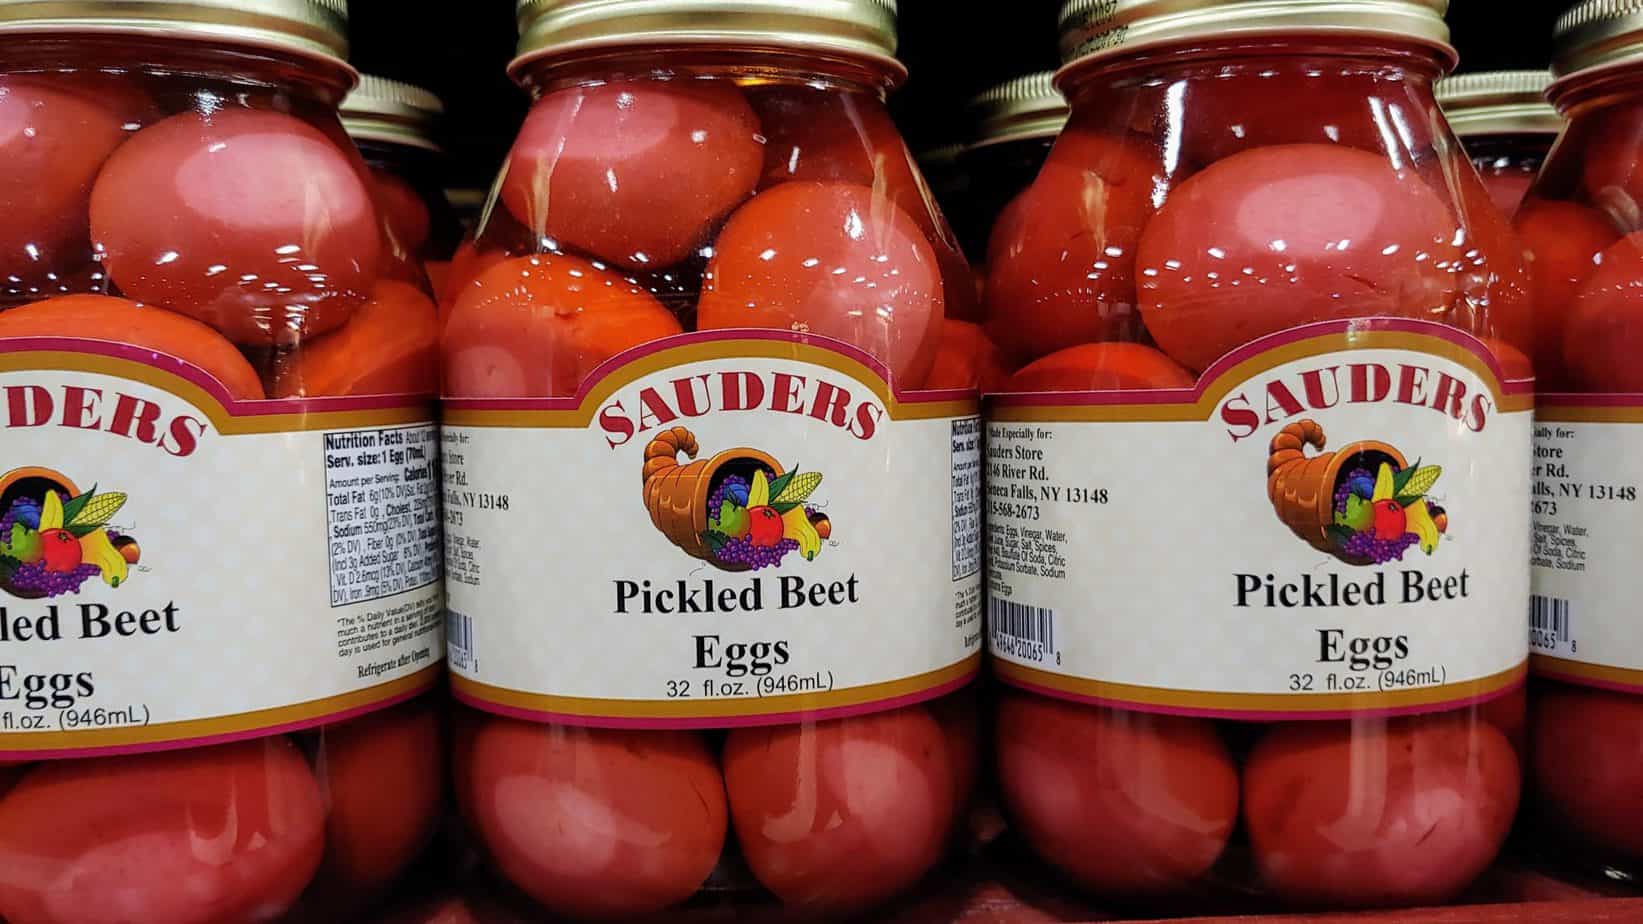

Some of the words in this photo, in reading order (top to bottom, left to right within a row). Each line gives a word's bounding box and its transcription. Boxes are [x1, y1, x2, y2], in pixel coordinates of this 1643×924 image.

[599, 371, 883, 449] SAUDERS
[1220, 363, 1492, 442] SAUDERS
[3, 385, 207, 457] DERS
[326, 432, 375, 450] Nutrition
[379, 430, 403, 446] Facts
[1002, 427, 1034, 441] Especially
[1036, 427, 1053, 439] for:
[327, 454, 355, 468] Serv.
[357, 451, 381, 466] size:
[389, 448, 404, 465] Egg
[1015, 445, 1043, 460] Store
[1002, 463, 1026, 480] River
[1029, 466, 1049, 481] Rd.
[1546, 463, 1569, 478] Rd.
[329, 476, 360, 489] Amount
[1559, 483, 1583, 498] NY
[1589, 485, 1637, 501] 13148
[327, 491, 350, 506] Total
[352, 489, 366, 503] Fat
[463, 492, 476, 508] NY
[479, 493, 509, 510] 13148
[1010, 483, 1038, 502] Falls,
[1040, 486, 1061, 501] NY
[1066, 487, 1109, 504] 13148
[333, 524, 363, 539] Sodium
[1045, 529, 1068, 544] Water,
[1040, 566, 1066, 579] Sodium
[613, 578, 765, 613] Pickled
[777, 573, 859, 609] Beet
[1232, 572, 1386, 607] Pickled
[1399, 568, 1470, 604] Beet
[76, 600, 181, 639] Beet
[692, 635, 789, 677] Eggs
[1316, 629, 1409, 671] Eggs
[358, 657, 397, 679] Refrigerate
[0, 665, 94, 710] Eggs
[666, 680, 690, 698] 32
[703, 680, 749, 698] fl.oz.
[757, 671, 833, 698] (946mL)
[1289, 674, 1313, 691] 32
[1326, 674, 1371, 691] fl.oz.
[1378, 666, 1446, 693] (946mL)
[2, 712, 51, 730] fl.oz.
[59, 704, 150, 731] (946mL)
